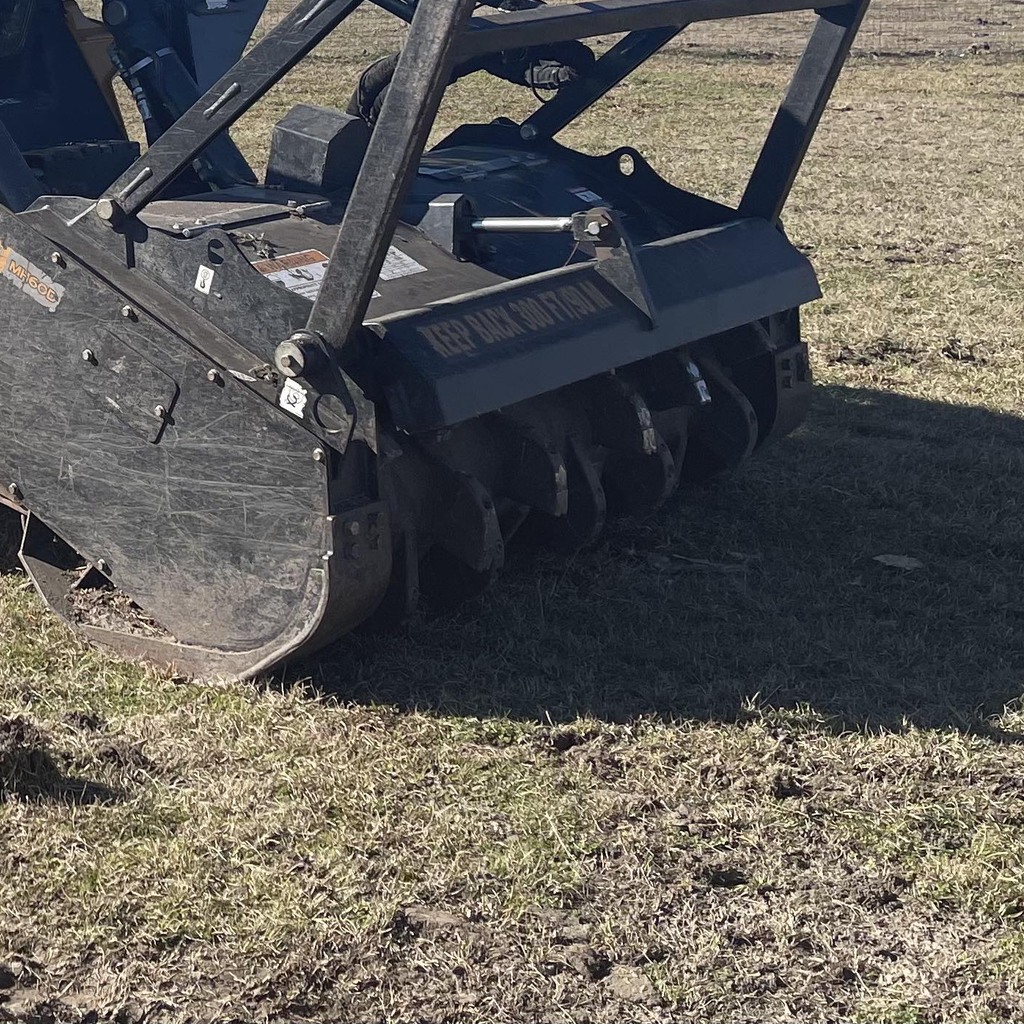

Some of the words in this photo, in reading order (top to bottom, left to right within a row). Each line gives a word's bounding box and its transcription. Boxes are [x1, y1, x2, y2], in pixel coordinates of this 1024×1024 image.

[417, 319, 477, 358] KEEP
[464, 306, 526, 343] BACK
[509, 297, 554, 331] 300
